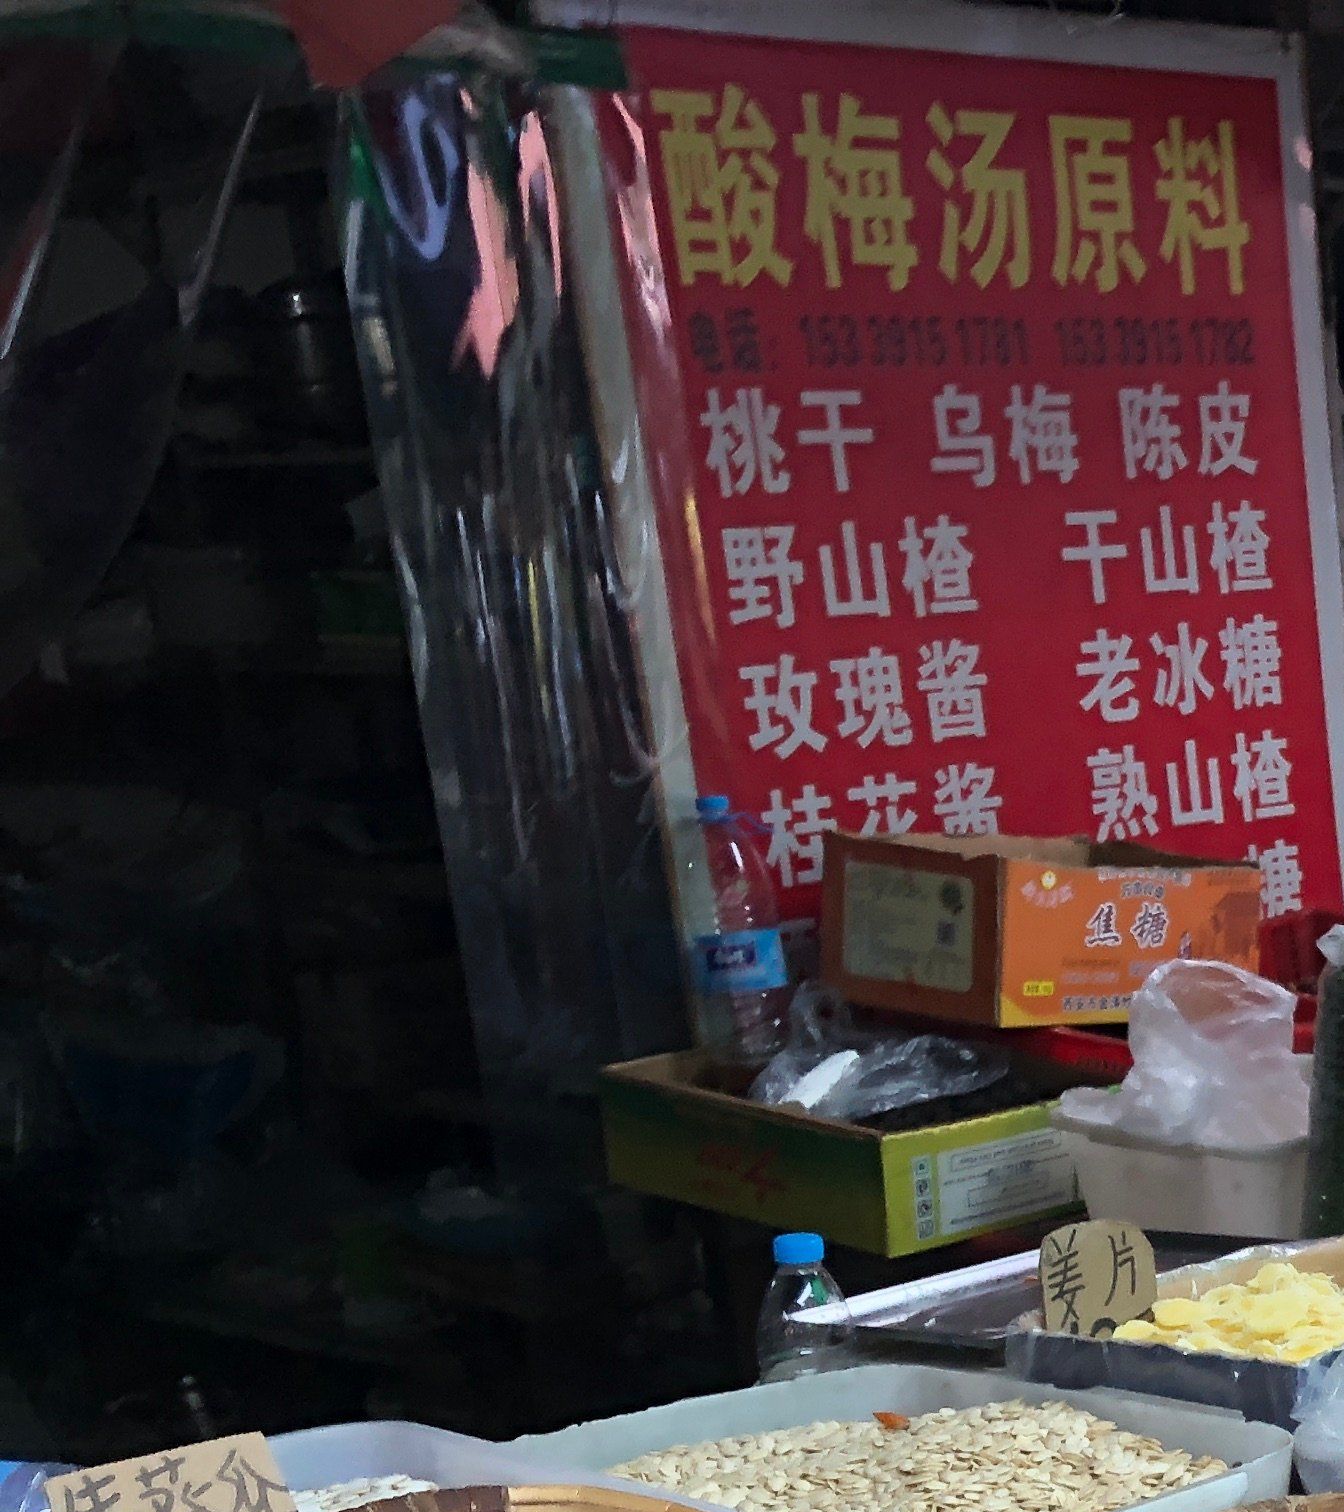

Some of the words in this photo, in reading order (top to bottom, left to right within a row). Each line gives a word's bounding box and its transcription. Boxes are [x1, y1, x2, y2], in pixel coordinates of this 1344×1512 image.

[652, 84, 1250, 294] 酸梅汤原料
[702, 387, 875, 498] 桃干
[931, 383, 1078, 488] 乌梅
[1119, 381, 1259, 482] 陈皮
[722, 513, 980, 628] 野山楂
[1062, 501, 1274, 605] 干山楂
[740, 637, 987, 760] 玫瑰酱
[1076, 612, 1284, 725] 老冰糖
[1087, 729, 1296, 842] 熟山楂
[1048, 1229, 1135, 1328] 姜片
